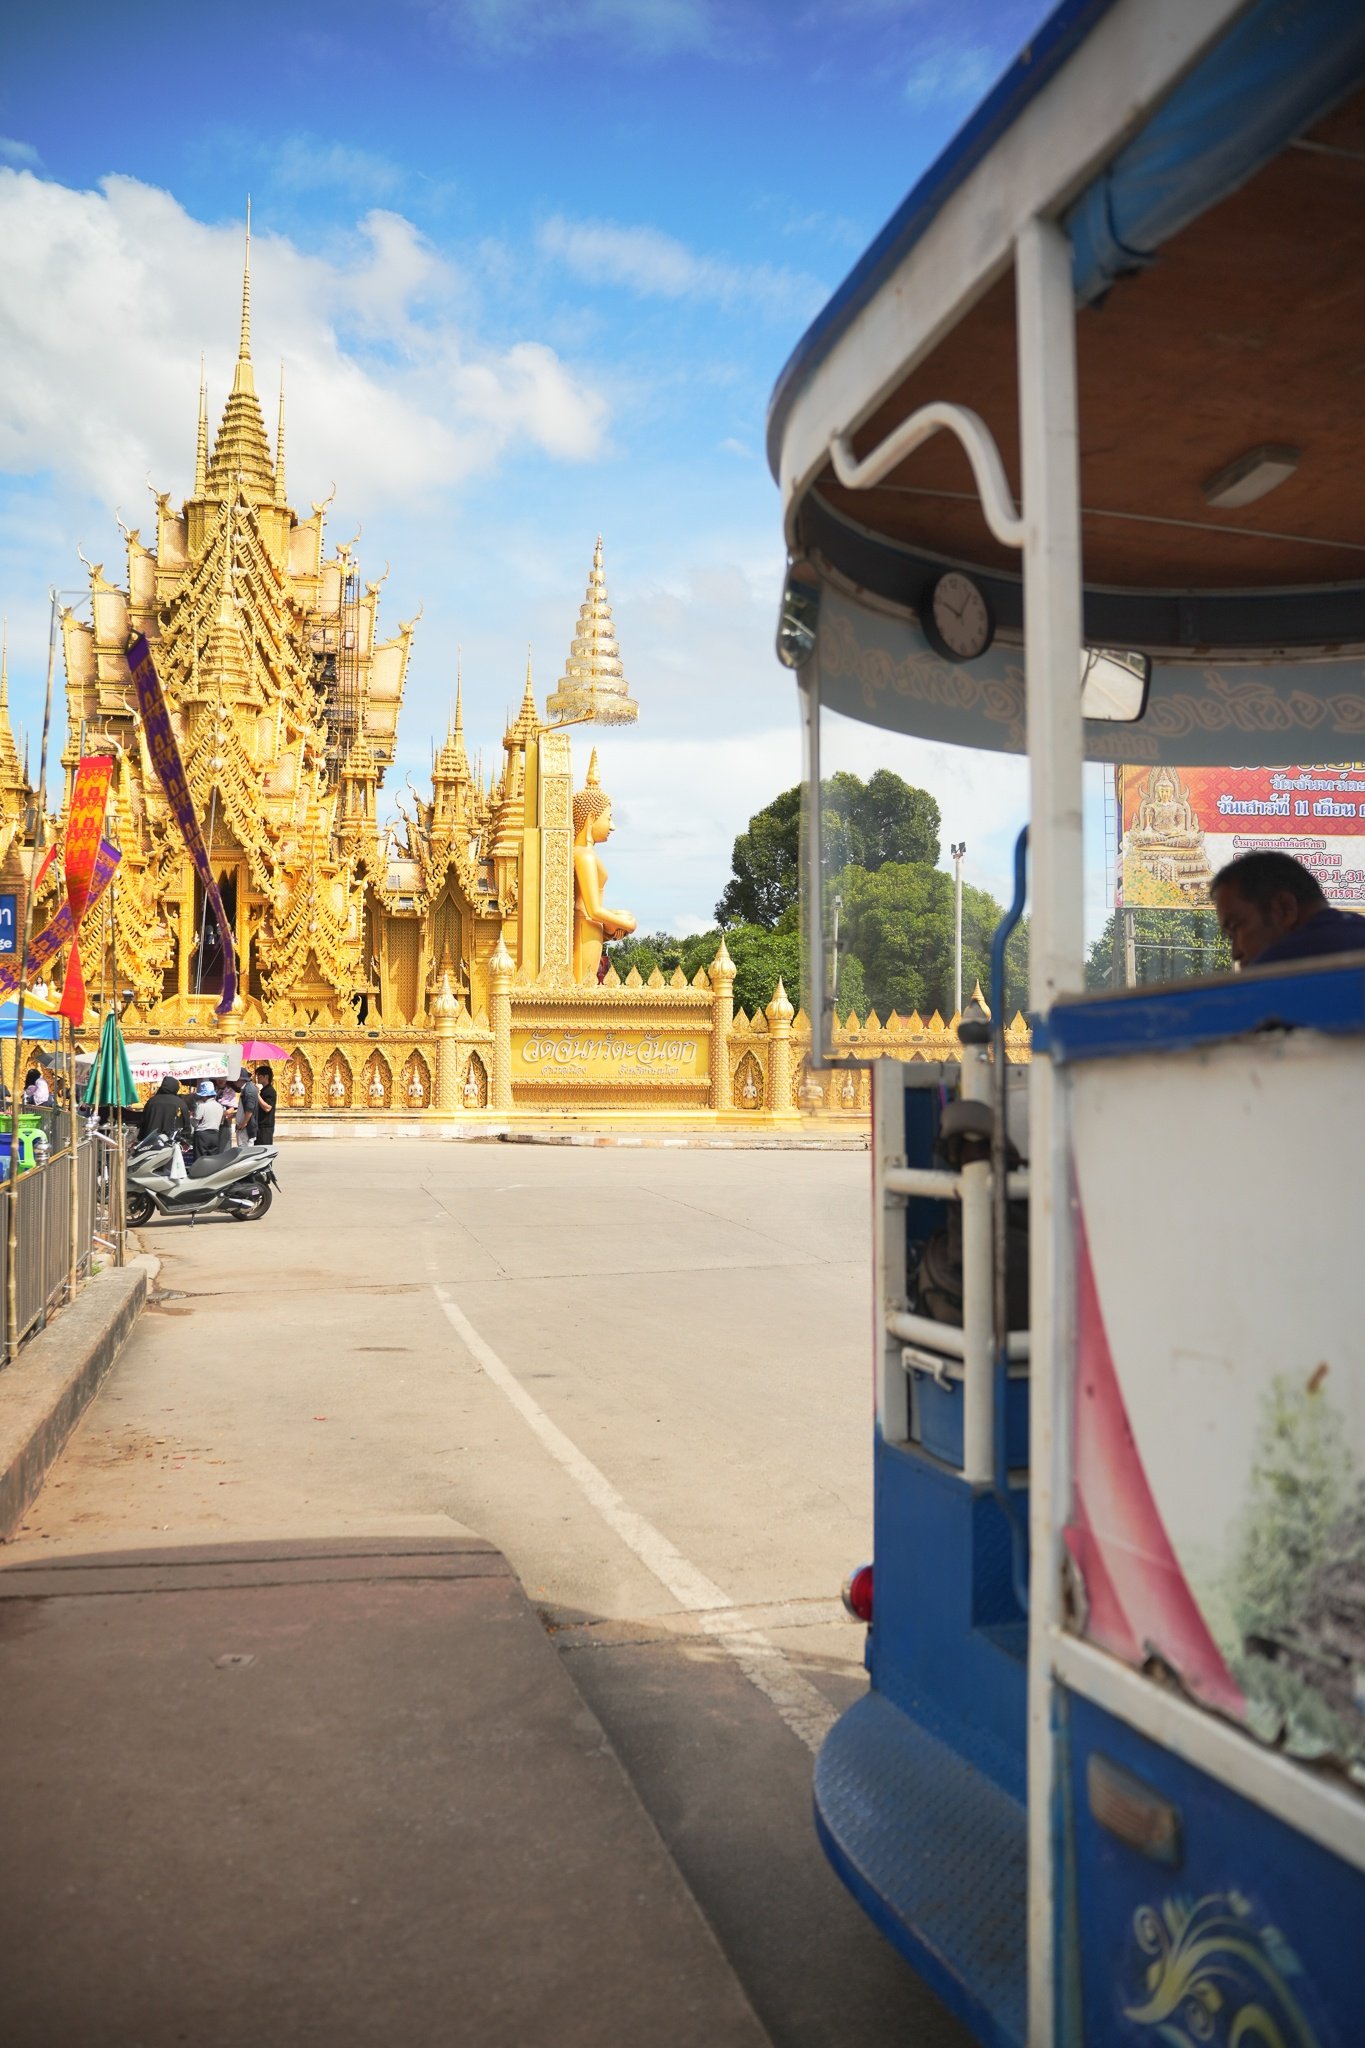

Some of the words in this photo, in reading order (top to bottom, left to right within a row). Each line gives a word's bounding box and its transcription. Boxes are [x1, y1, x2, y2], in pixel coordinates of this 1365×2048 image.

[1217, 794, 1290, 815] วันเสาร์ที่
[1295, 800, 1309, 816] 11
[1314, 798, 1356, 817] เดือน
[522, 1030, 698, 1064] วัดจันทร์ตะวันตก
